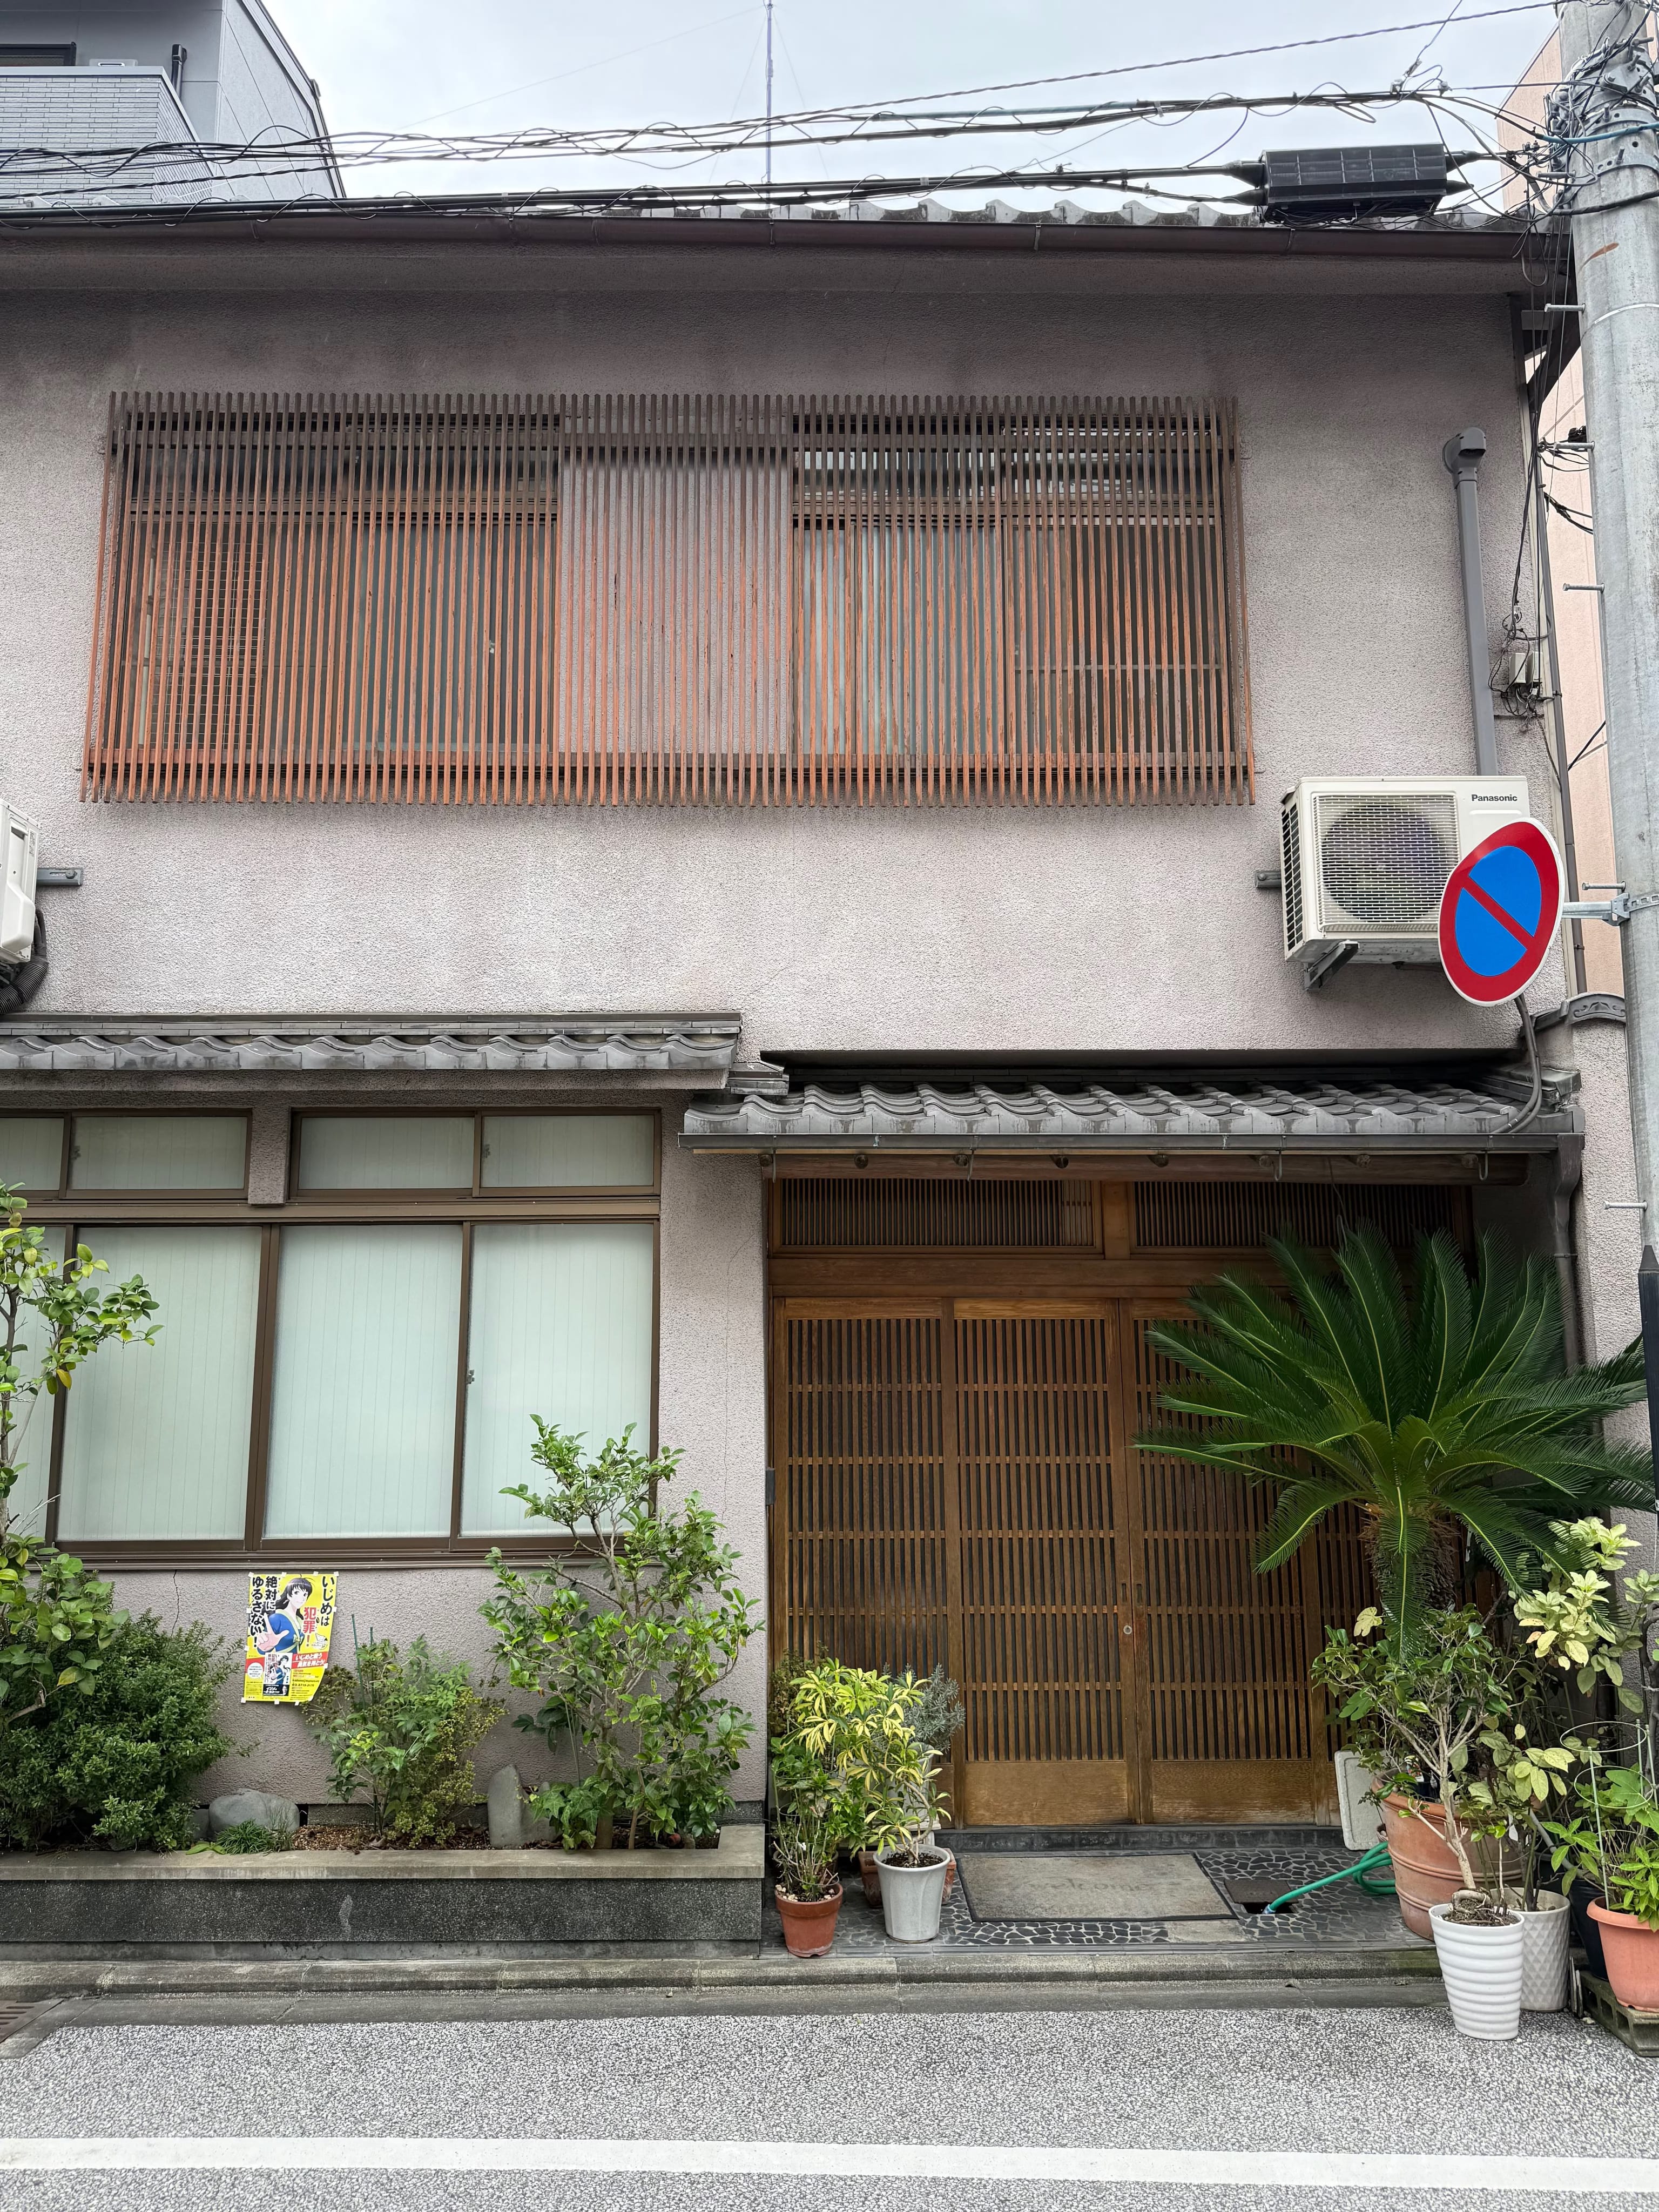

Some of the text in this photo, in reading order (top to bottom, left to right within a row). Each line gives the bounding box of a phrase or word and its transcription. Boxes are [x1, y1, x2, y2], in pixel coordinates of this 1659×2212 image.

[250, 1576, 264, 1648] ゆるさない！
[265, 1576, 278, 1610] 絶対に
[320, 1576, 335, 1627] いじめは
[302, 1607, 316, 1647] 犯罪！
